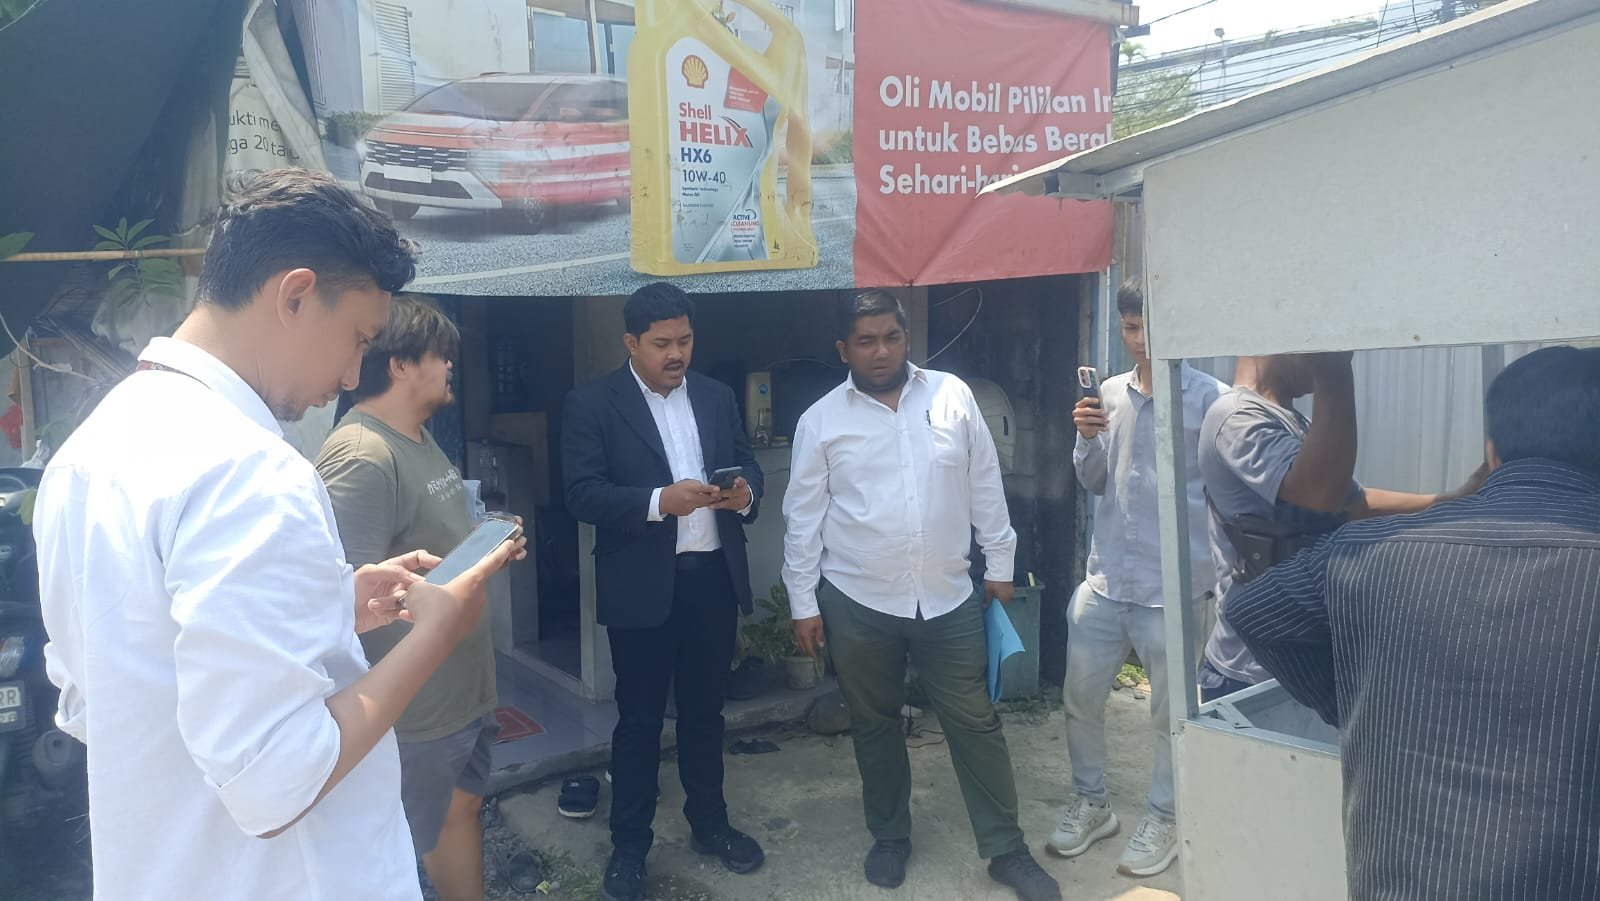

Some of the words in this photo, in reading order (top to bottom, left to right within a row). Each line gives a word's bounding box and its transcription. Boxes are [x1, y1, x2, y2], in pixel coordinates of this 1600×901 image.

[880, 75, 920, 107] Oli
[929, 80, 1000, 113] Mobil
[679, 102, 712, 120] Shell
[679, 117, 753, 148] HELIX
[879, 122, 959, 153] untuk
[967, 124, 1038, 154] Bebas
[681, 147, 712, 164] HX6
[682, 169, 726, 184] 10W-40
